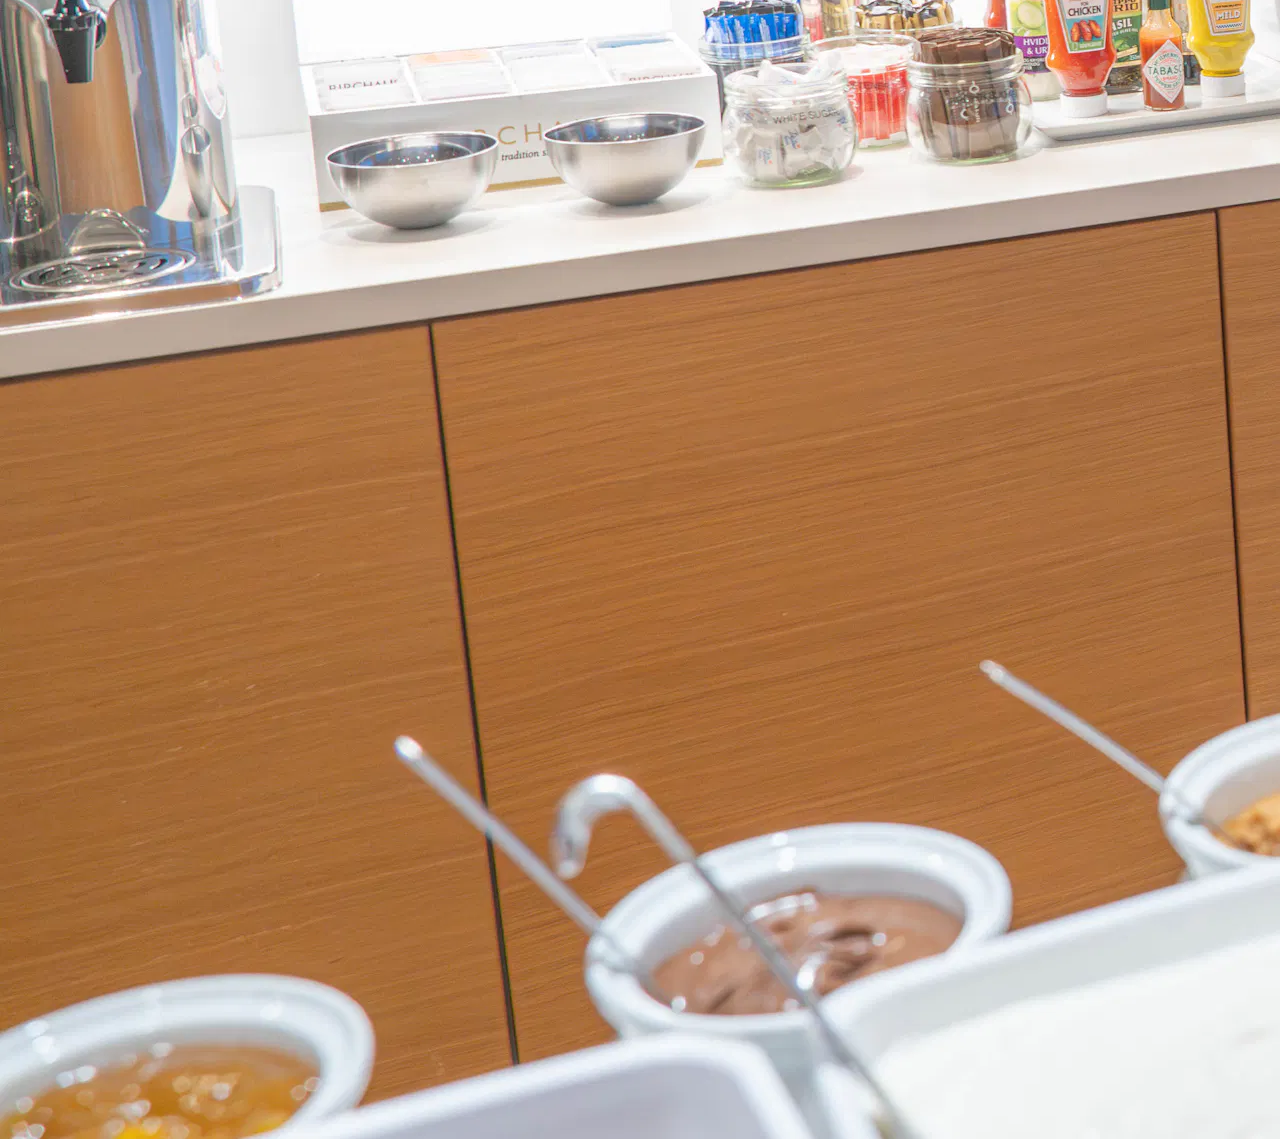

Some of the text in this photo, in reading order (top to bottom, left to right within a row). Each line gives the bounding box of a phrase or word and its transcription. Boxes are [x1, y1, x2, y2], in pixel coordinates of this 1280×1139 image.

[1068, 5, 1102, 17] CHICKEN
[1114, 3, 1139, 12] RIO
[1216, 10, 1240, 21] MILD
[1112, 18, 1133, 31] ASIL
[1035, 46, 1048, 54] UR
[773, 112, 806, 125] WHITE
[501, 147, 539, 162] tradition
